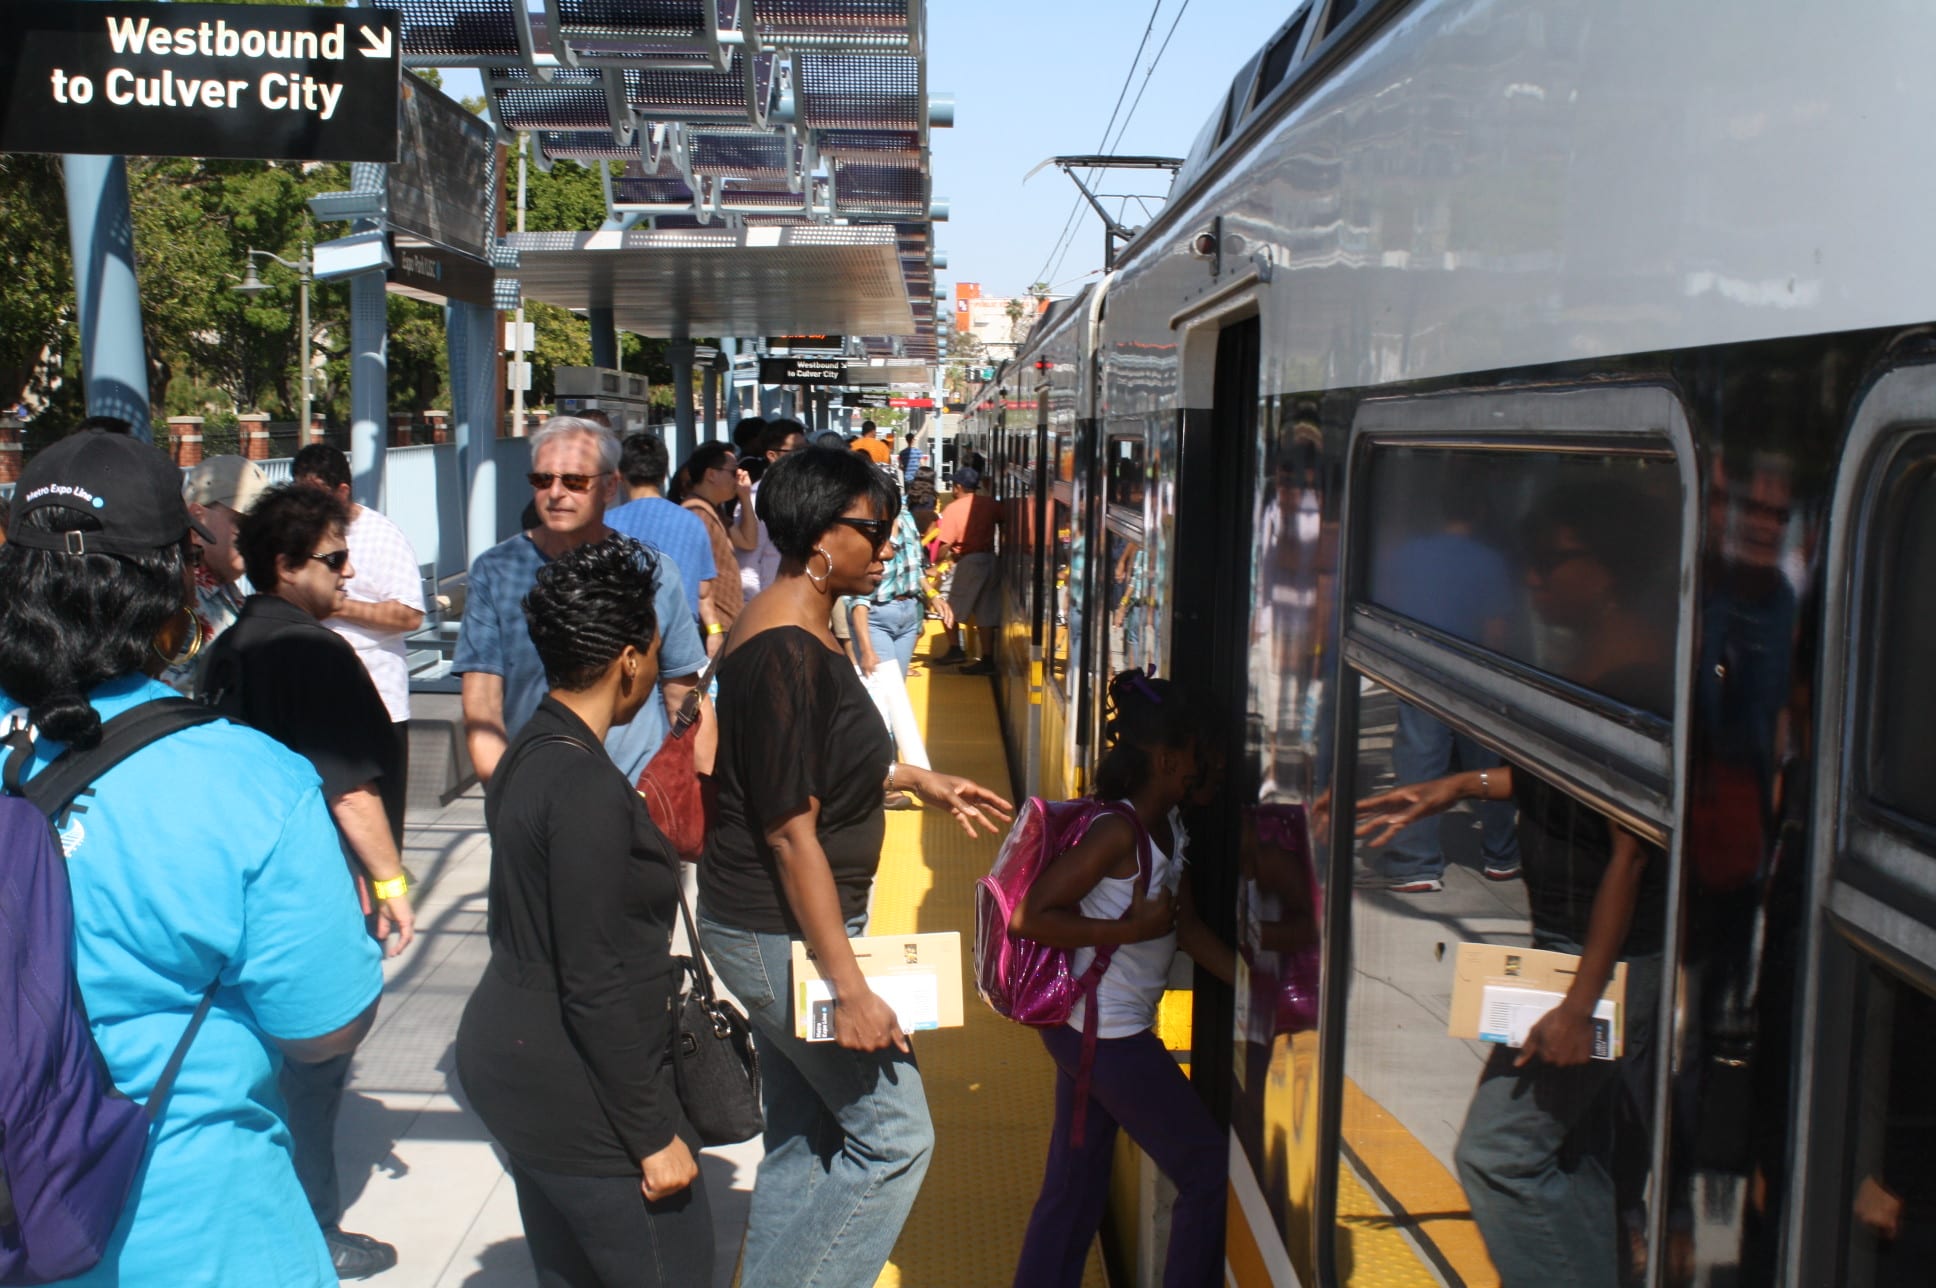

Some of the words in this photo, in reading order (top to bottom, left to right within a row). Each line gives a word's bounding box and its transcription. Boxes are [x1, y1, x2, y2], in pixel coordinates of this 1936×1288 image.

[107, 16, 345, 60] Westbound
[51, 68, 94, 104] to
[106, 68, 248, 109] Culver
[259, 72, 344, 120] City
[797, 361, 839, 369] Westbound
[797, 370, 821, 378] Culver
[823, 371, 839, 379] City
[26, 486, 50, 502] Metro
[50, 483, 73, 495] Expo
[73, 486, 93, 502] Line
